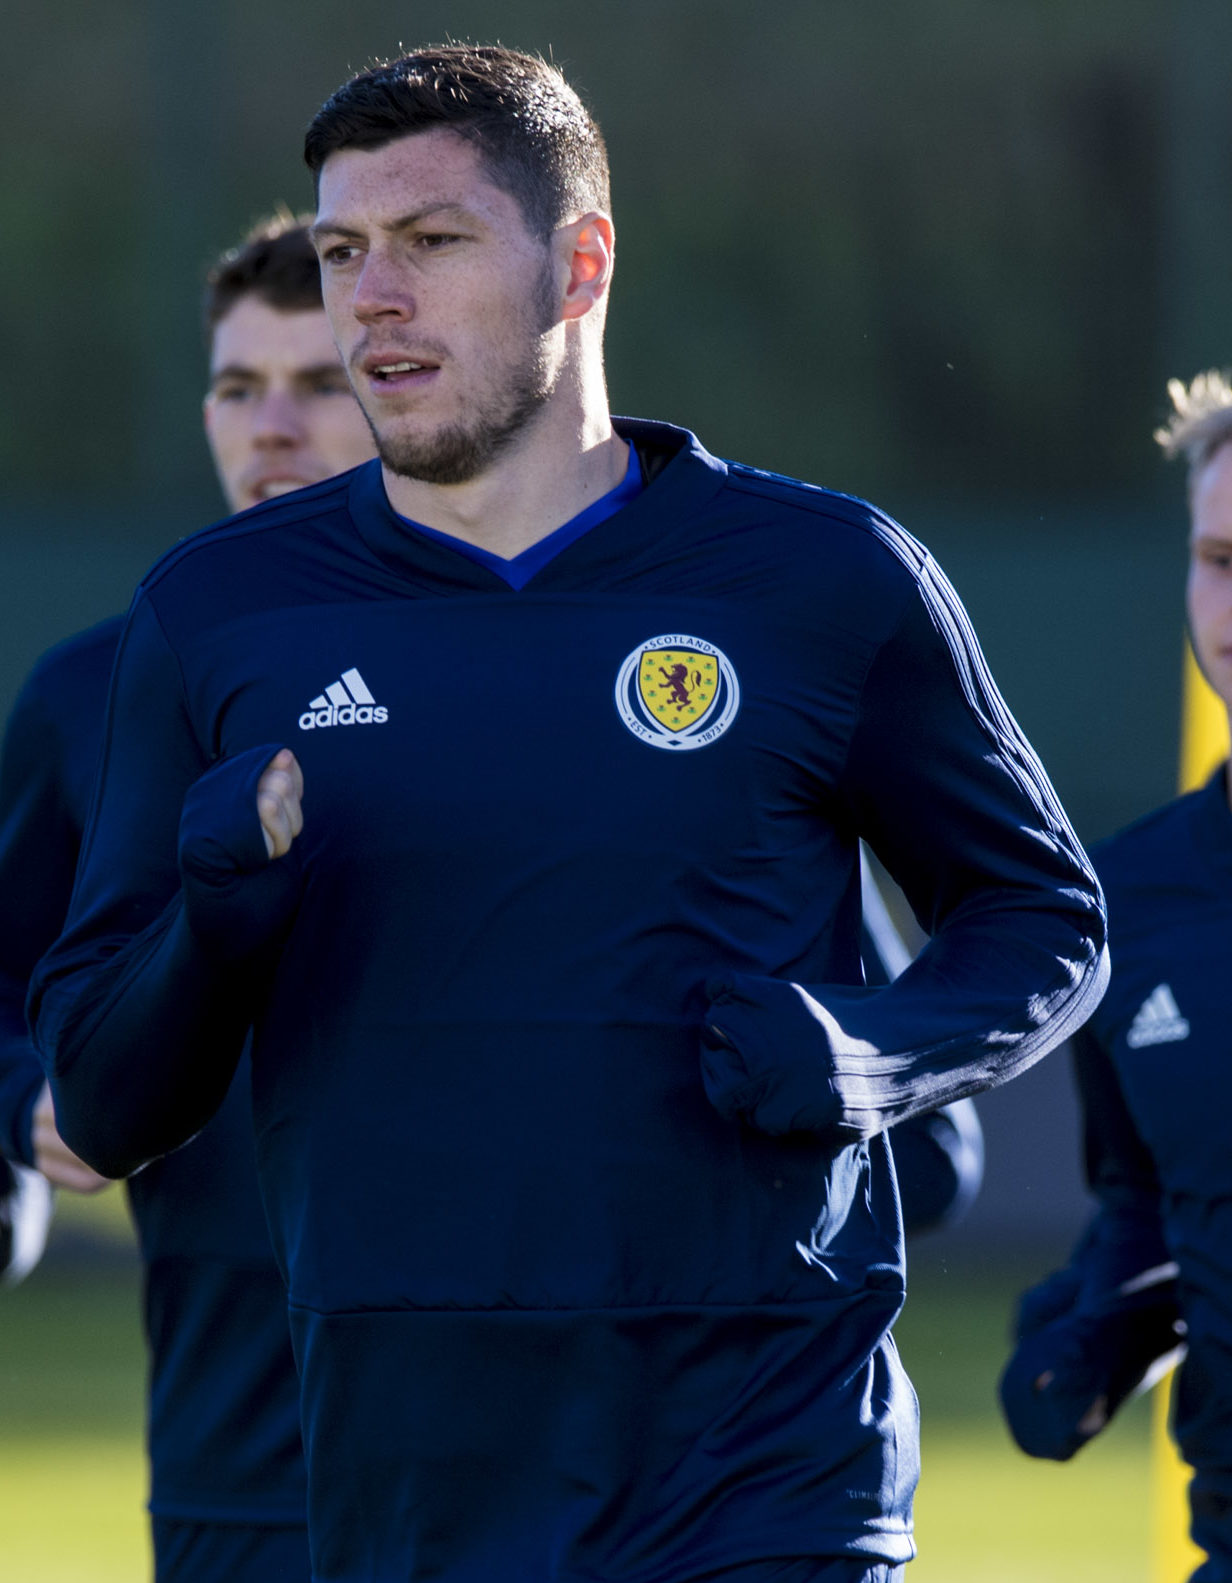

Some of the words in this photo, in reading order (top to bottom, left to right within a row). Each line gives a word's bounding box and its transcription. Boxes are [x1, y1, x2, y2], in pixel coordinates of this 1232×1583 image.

[650, 636, 711, 652] SCOTLAND
[298, 703, 389, 730] adidas
[630, 720, 647, 735] EST
[702, 725, 722, 742] 1873
